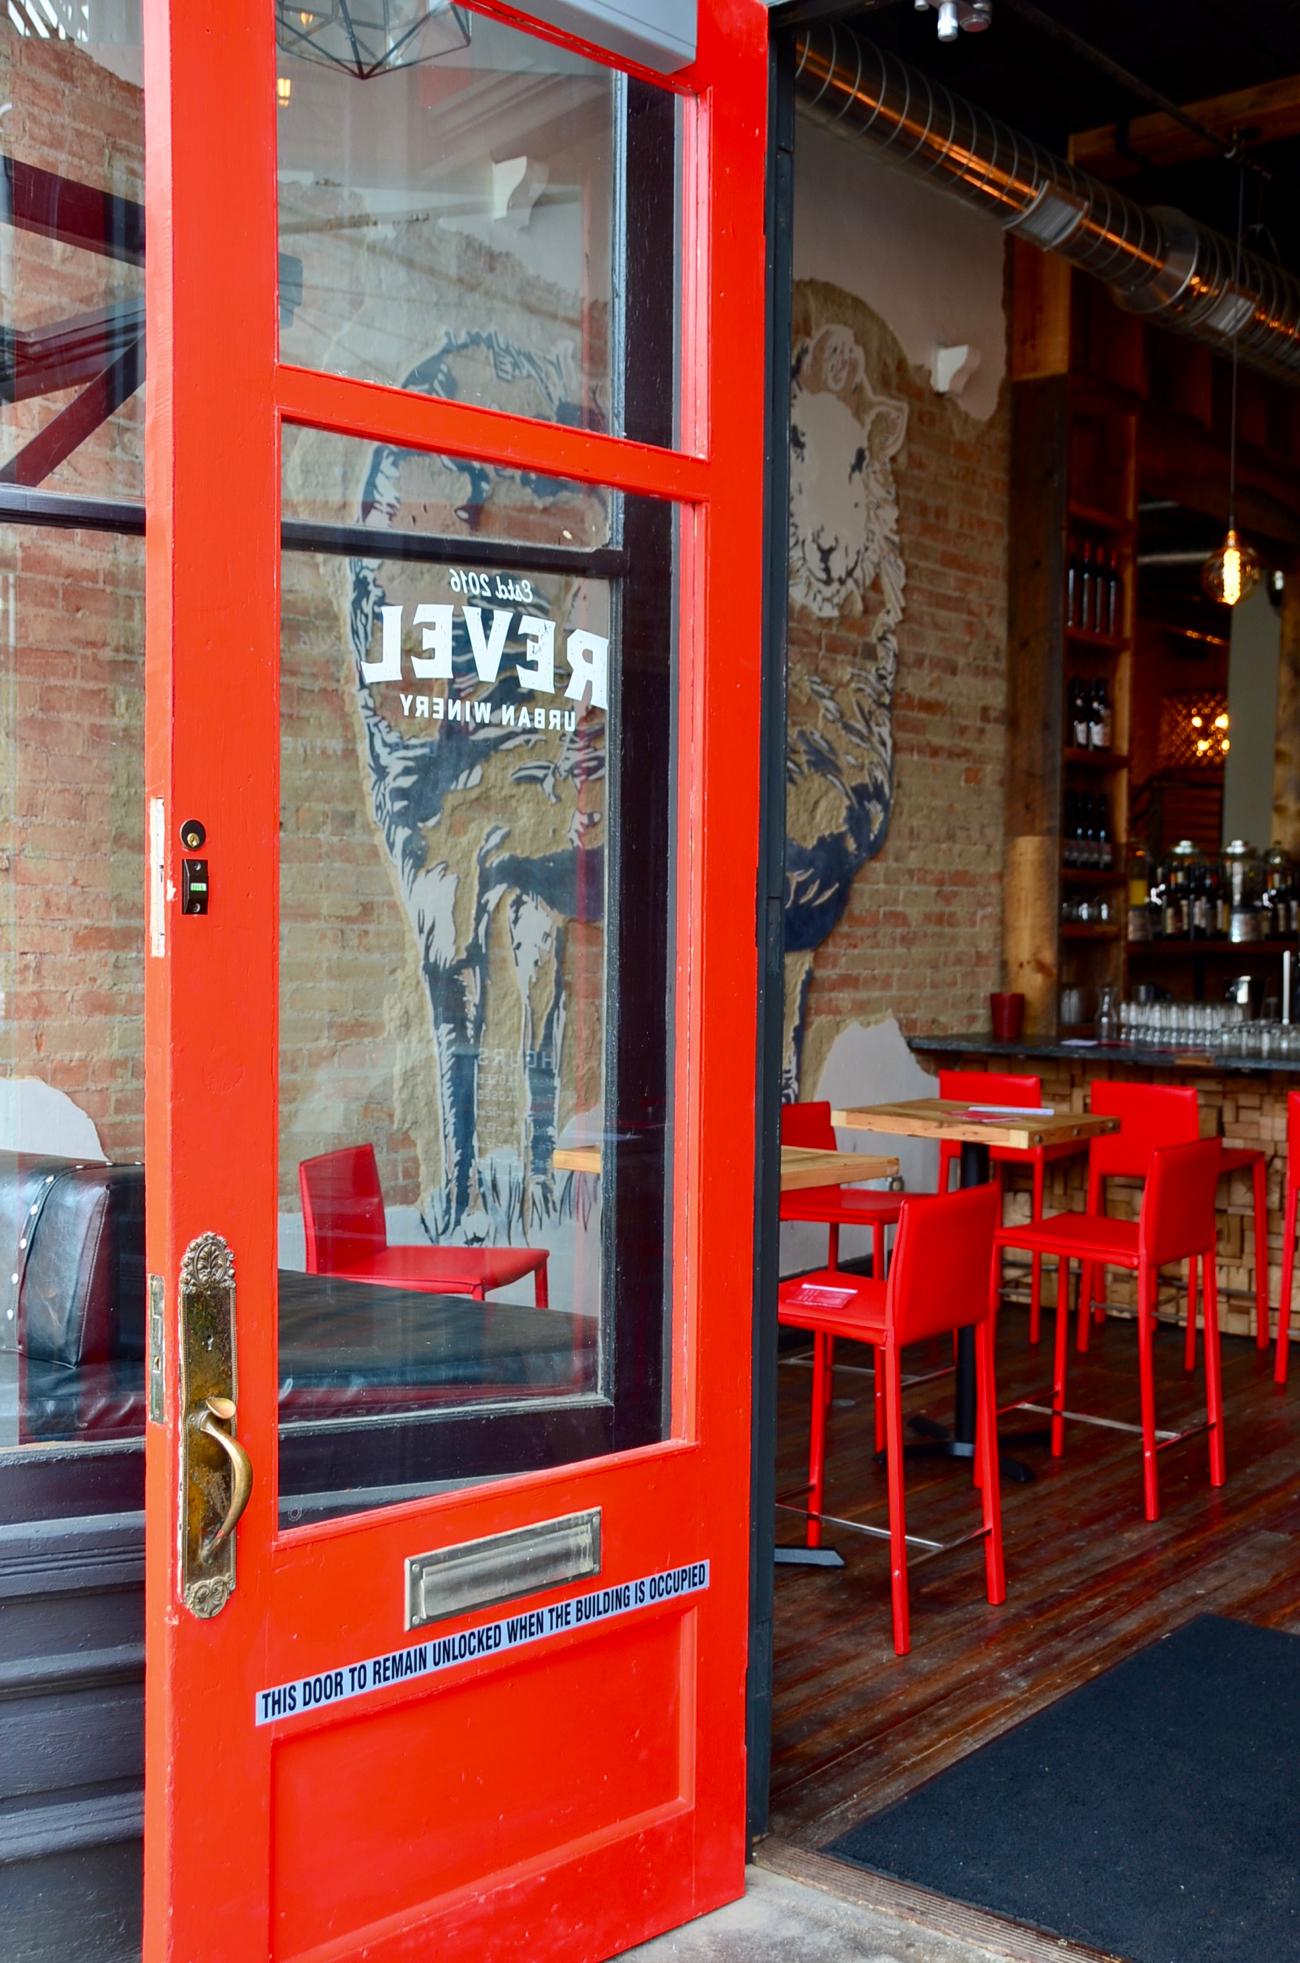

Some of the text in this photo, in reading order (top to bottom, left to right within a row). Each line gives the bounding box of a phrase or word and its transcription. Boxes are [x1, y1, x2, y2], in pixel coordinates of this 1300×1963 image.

[261, 1563, 706, 1719] THIS DOOR TO REMAIN UNLOCKED WHEN THE BUILDING IS OCCUPIED
